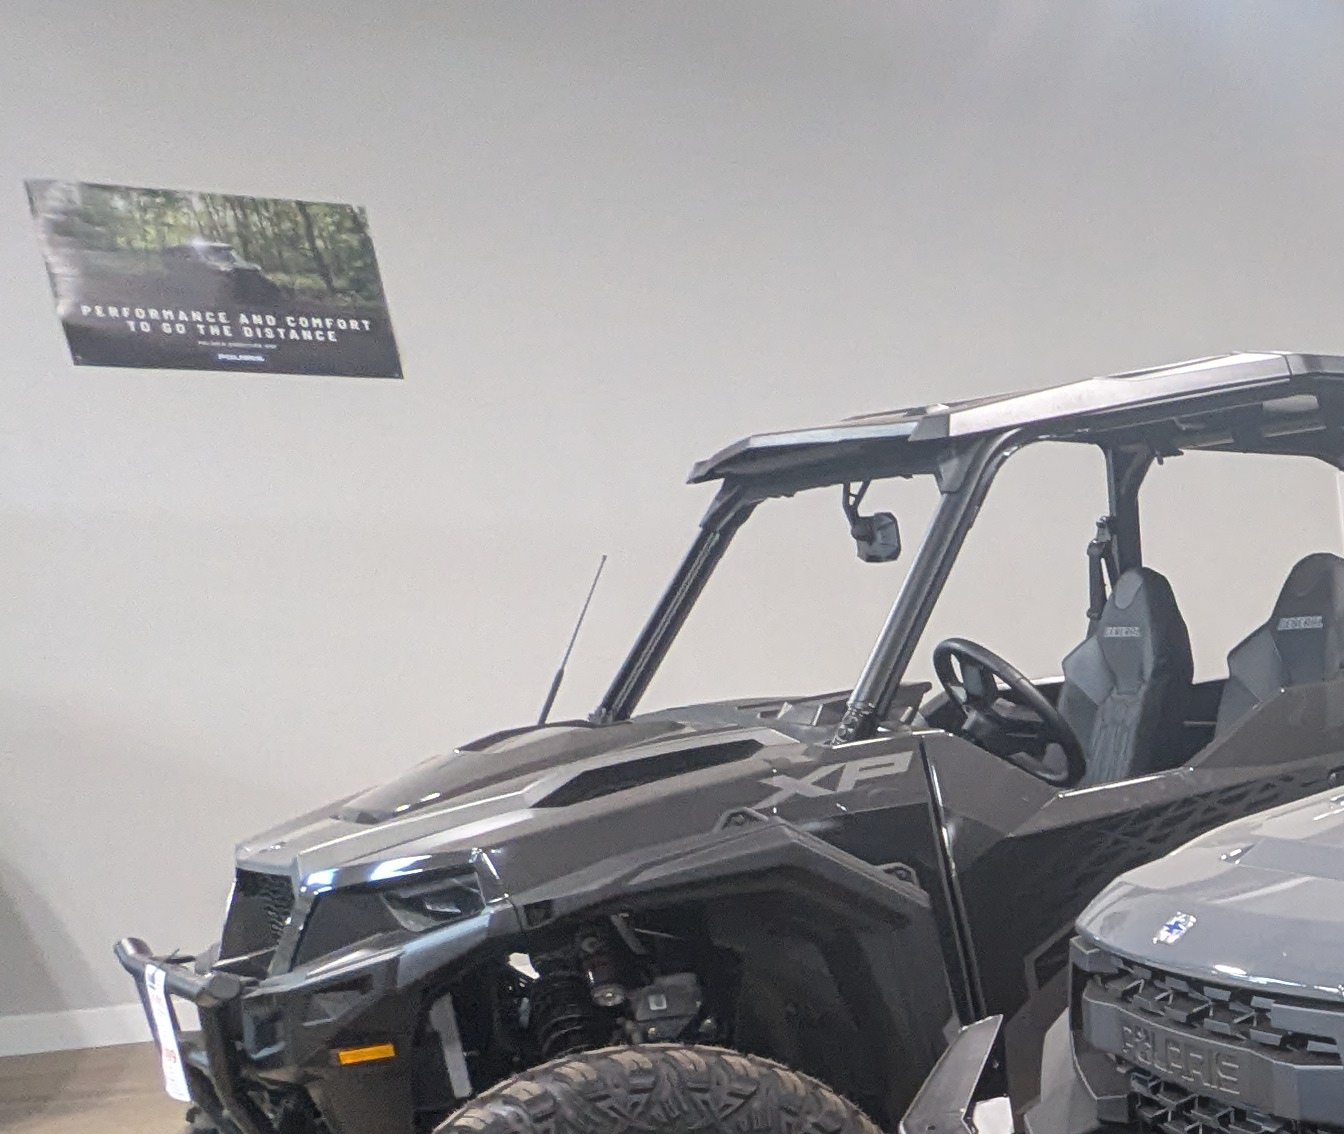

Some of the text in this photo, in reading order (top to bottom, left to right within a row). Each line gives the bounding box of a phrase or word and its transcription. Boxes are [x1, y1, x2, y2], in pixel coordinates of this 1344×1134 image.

[80, 304, 371, 332] PERFORMANCE AND COMFORT
[126, 320, 338, 342] TO GO THE DISTANCE
[752, 751, 913, 810] XP
[1122, 1025, 1240, 1095] POLARIS
